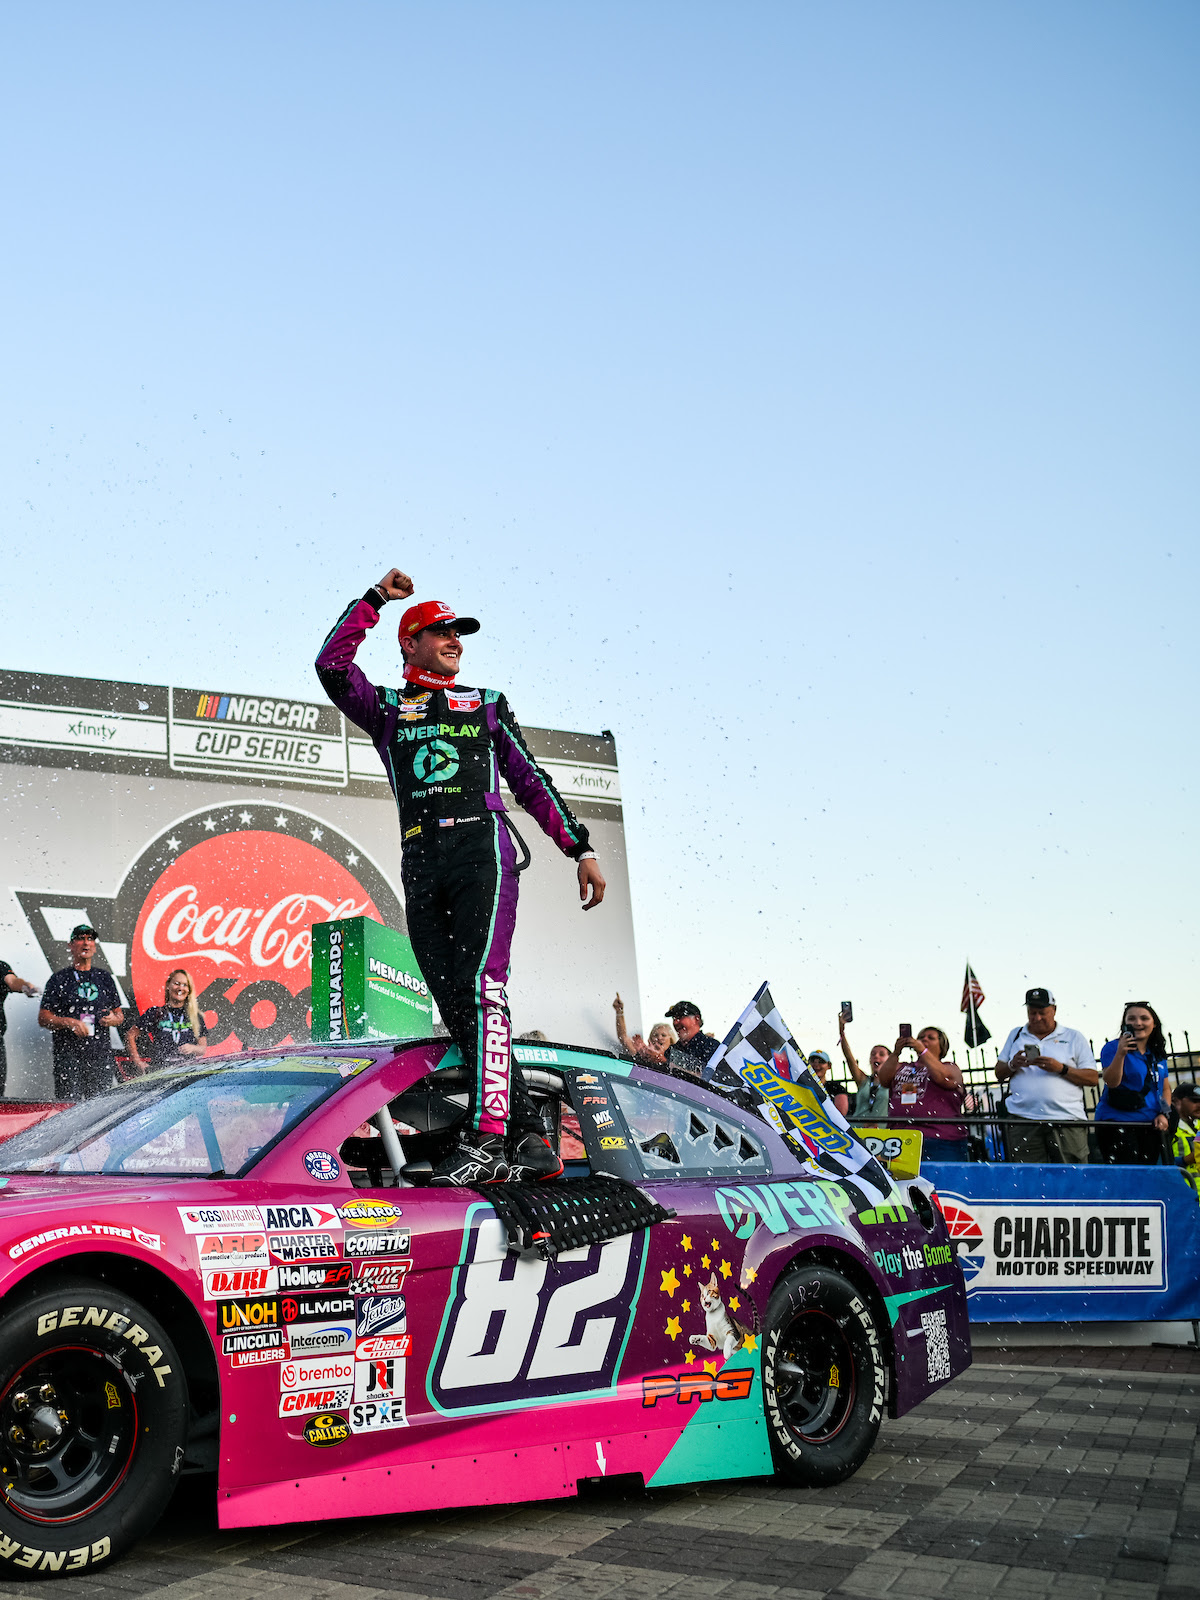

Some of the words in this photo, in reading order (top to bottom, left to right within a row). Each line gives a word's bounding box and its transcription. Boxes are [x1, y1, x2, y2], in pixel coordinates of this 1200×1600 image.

[225, 698, 319, 731] NASCAR
[68, 721, 117, 740] xfinity
[194, 732, 242, 755] CUP
[244, 738, 322, 764] SERIES
[572, 773, 611, 790] xfinity
[412, 790, 427, 799] Play
[428, 786, 442, 795] the
[142, 884, 370, 969] Coca-Co
[329, 930, 343, 1040] MENARDS
[369, 957, 428, 996] MENARDS
[514, 1048, 558, 1062] GREEN
[583, 1096, 608, 1105] PRG
[745, 1066, 848, 1150] SUNOCO
[592, 1110, 612, 1125] WIX
[305, 1151, 332, 1163] NASCAR
[310, 1168, 339, 1180] SALUTES
[266, 1207, 314, 1229] ARCA
[336, 1206, 403, 1219] MENARDS
[715, 1180, 908, 1240] OVERPAY
[9, 1225, 91, 1259] GENERAL
[91, 1224, 132, 1239] TIRE
[200, 1235, 265, 1254] ARP
[269, 1234, 331, 1250] QUARTER
[346, 1235, 409, 1252] COMETIC
[993, 1216, 1151, 1258] CHARLOTTE
[283, 1246, 336, 1260] MASTER
[874, 1248, 903, 1278] Play
[902, 1244, 924, 1271] the
[923, 1243, 952, 1267] Game
[279, 1266, 327, 1288] Holley
[325, 1265, 351, 1284] EFI
[360, 1265, 407, 1284] KLOTZ
[996, 1261, 1061, 1276] MOTOR
[1064, 1261, 1154, 1276] SPEEDWAY
[212, 1267, 274, 1292] DART
[440, 1218, 633, 1391] 82
[787, 1280, 823, 1311] LR-2
[222, 1301, 277, 1328] UNOH
[300, 1300, 355, 1315] ILMOR
[357, 1296, 406, 1336] Jostens
[38, 1306, 172, 1388] GENERAL
[226, 1333, 280, 1352] LINCOLN
[291, 1334, 345, 1348] Intercomp
[356, 1335, 409, 1359] Eibach
[238, 1349, 285, 1365] WELDERS
[849, 1296, 885, 1424] GENERAL
[299, 1364, 352, 1381] brembo
[107, 1386, 119, 1406] AERO
[642, 1368, 754, 1409] PRG
[764, 1328, 802, 1460] GENERAL
[283, 1391, 335, 1411] COMP
[317, 1402, 342, 1410] CAMS
[309, 1425, 347, 1442] CALLIES
